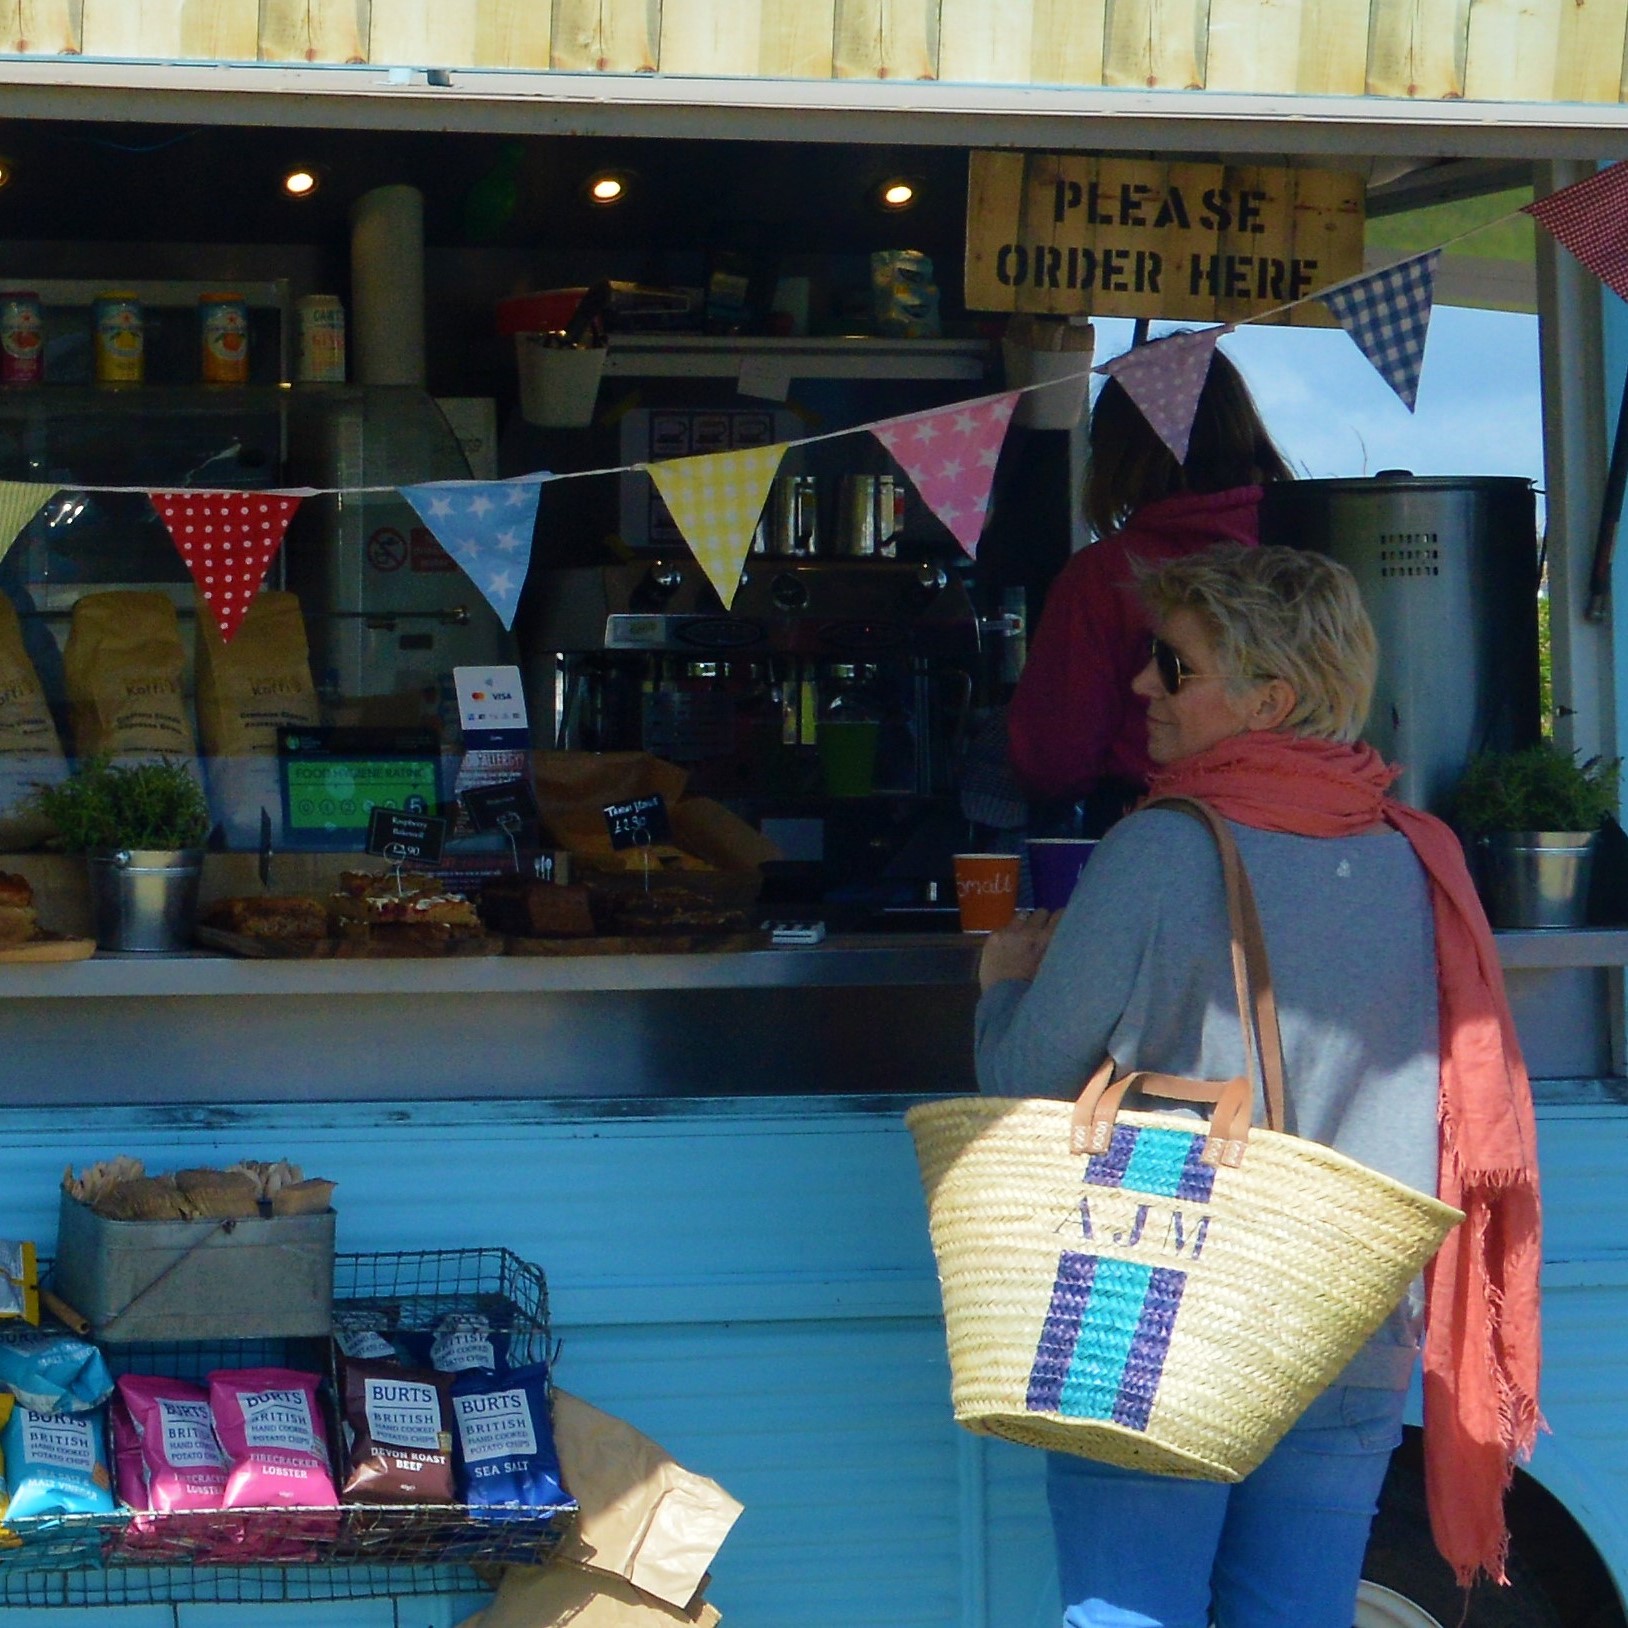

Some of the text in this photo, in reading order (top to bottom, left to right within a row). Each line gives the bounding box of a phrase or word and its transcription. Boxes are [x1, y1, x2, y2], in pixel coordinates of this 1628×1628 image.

[1054, 180, 1267, 234] PLEASE
[996, 244, 1318, 301] ORDER HERE
[492, 693, 512, 701] VISA
[246, 1391, 303, 1408] BURTS
[372, 1386, 433, 1403] BURTS
[164, 1402, 209, 1419] BURTS
[461, 1395, 522, 1414] BURTS
[251, 1411, 308, 1425] BRITISH
[373, 1412, 435, 1425] BRITISH
[466, 1419, 526, 1435] BRITISH
[30, 1432, 89, 1448] BRITISH
[371, 1447, 446, 1465] DEVON ROAST
[262, 1466, 308, 1479] LOBSTER
[396, 1459, 424, 1472] BEEF
[474, 1460, 529, 1478] SEA SALT
